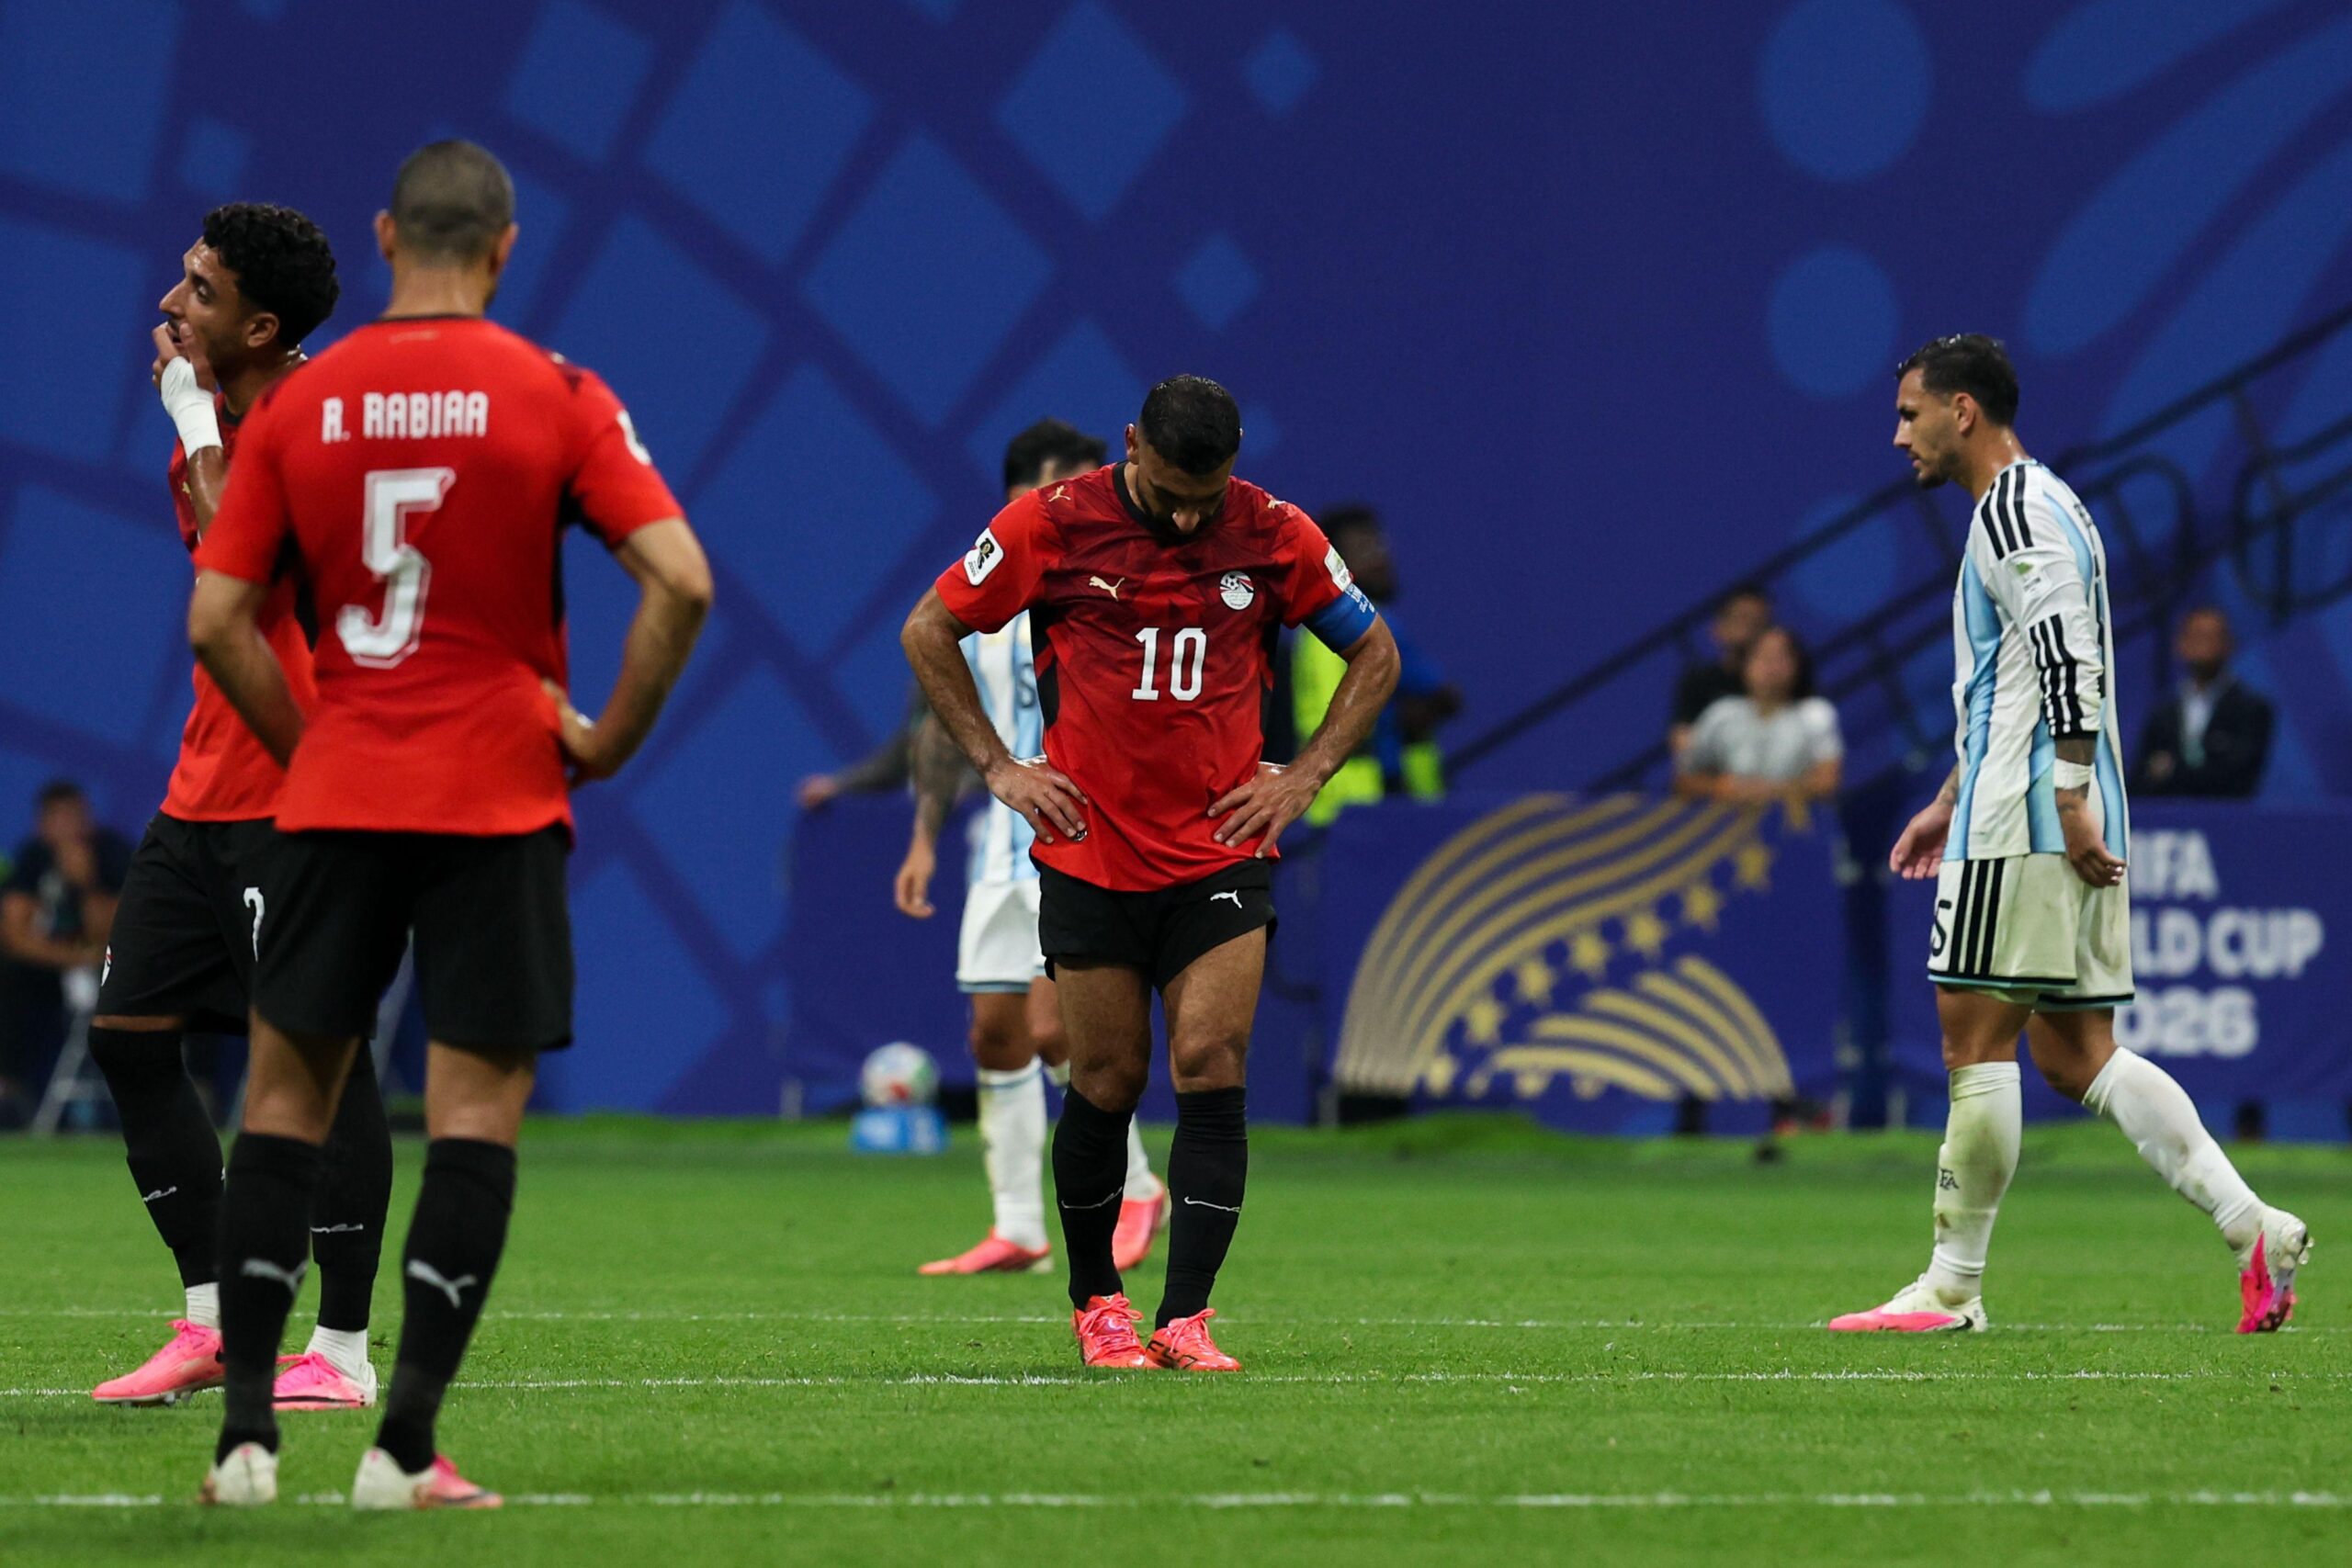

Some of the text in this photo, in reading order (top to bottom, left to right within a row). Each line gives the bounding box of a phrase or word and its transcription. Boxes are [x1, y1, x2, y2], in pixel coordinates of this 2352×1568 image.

[363, 390, 489, 440] RABIAA
[336, 467, 457, 670] 5
[1131, 626, 1207, 703] 10
[2131, 830, 2219, 900] IFA
[2131, 907, 2324, 979] LD CUP
[2112, 985, 2259, 1058] 026
